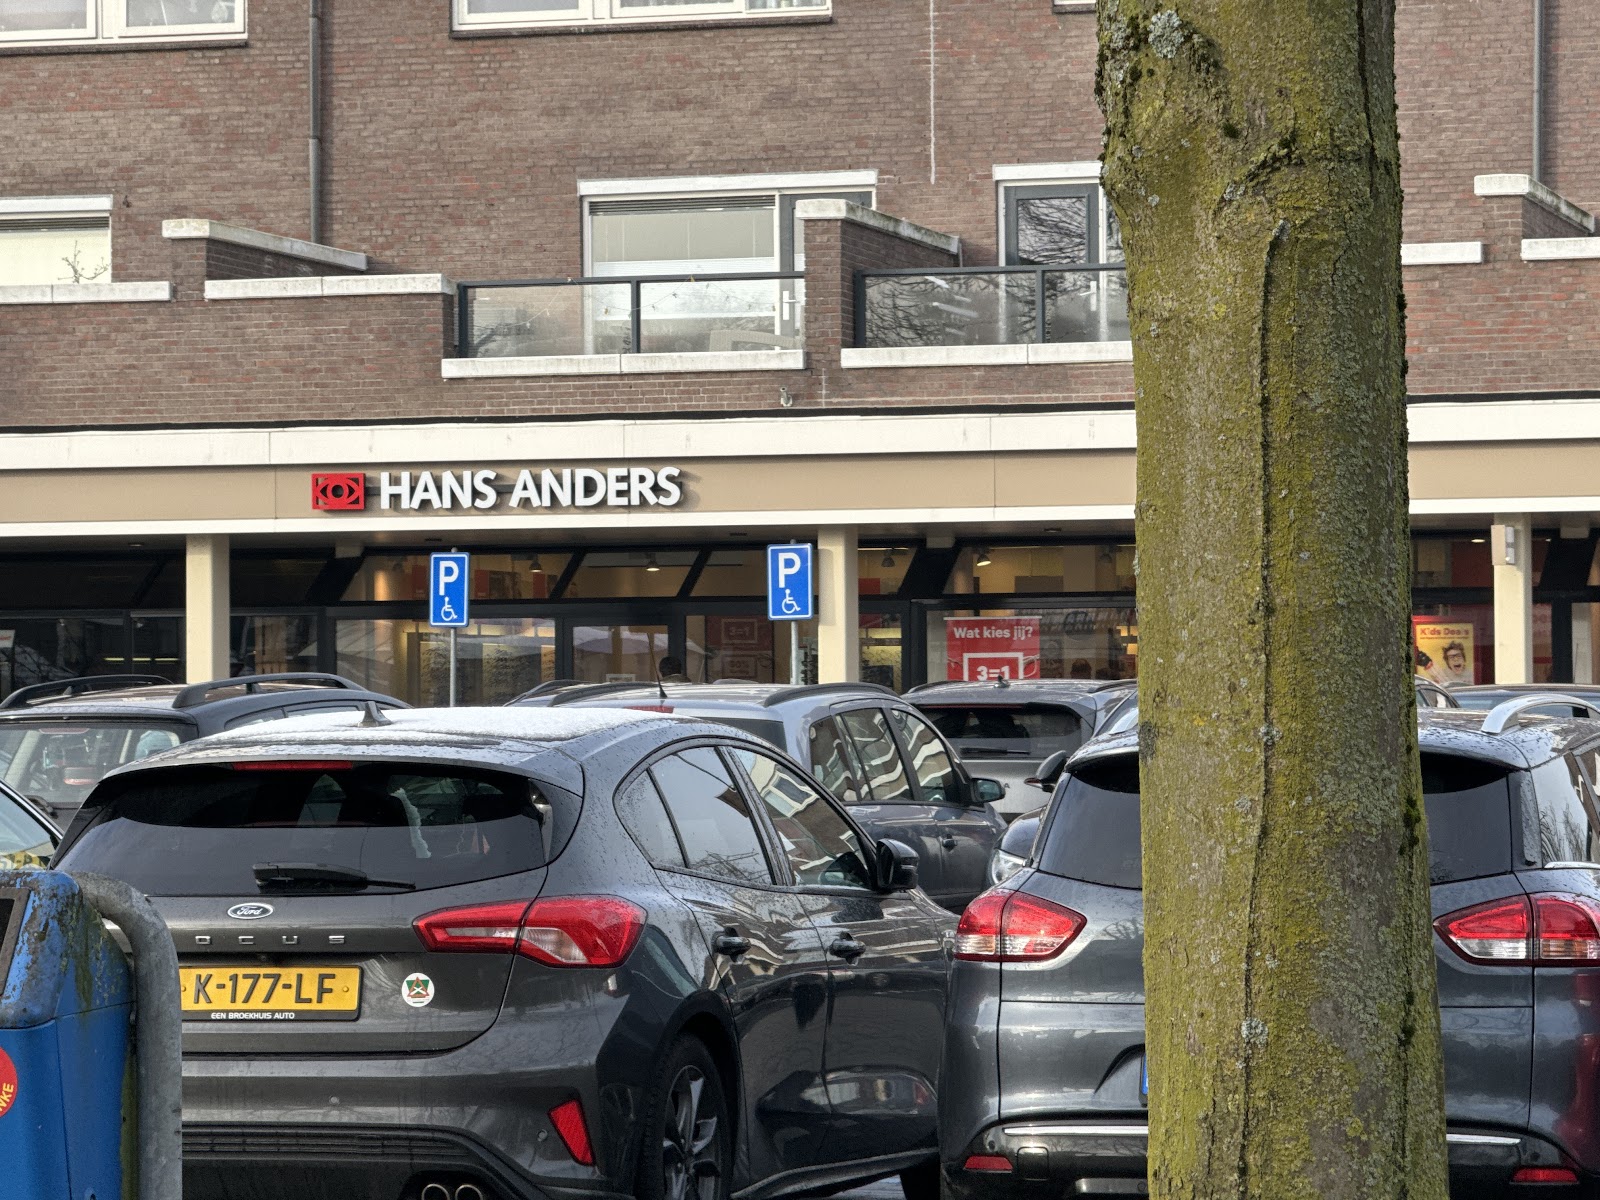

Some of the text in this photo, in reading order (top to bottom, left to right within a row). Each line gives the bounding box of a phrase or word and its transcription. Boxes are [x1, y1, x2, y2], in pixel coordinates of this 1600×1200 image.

[380, 467, 682, 509] HANS ANDERS
[439, 561, 459, 595] P
[778, 552, 801, 588] P
[953, 626, 1033, 640] Wat kies jij?
[977, 665, 1010, 680] 3=1
[236, 905, 264, 916] Ford
[195, 935, 345, 945] OCUS
[193, 973, 336, 1004] K-177-LF
